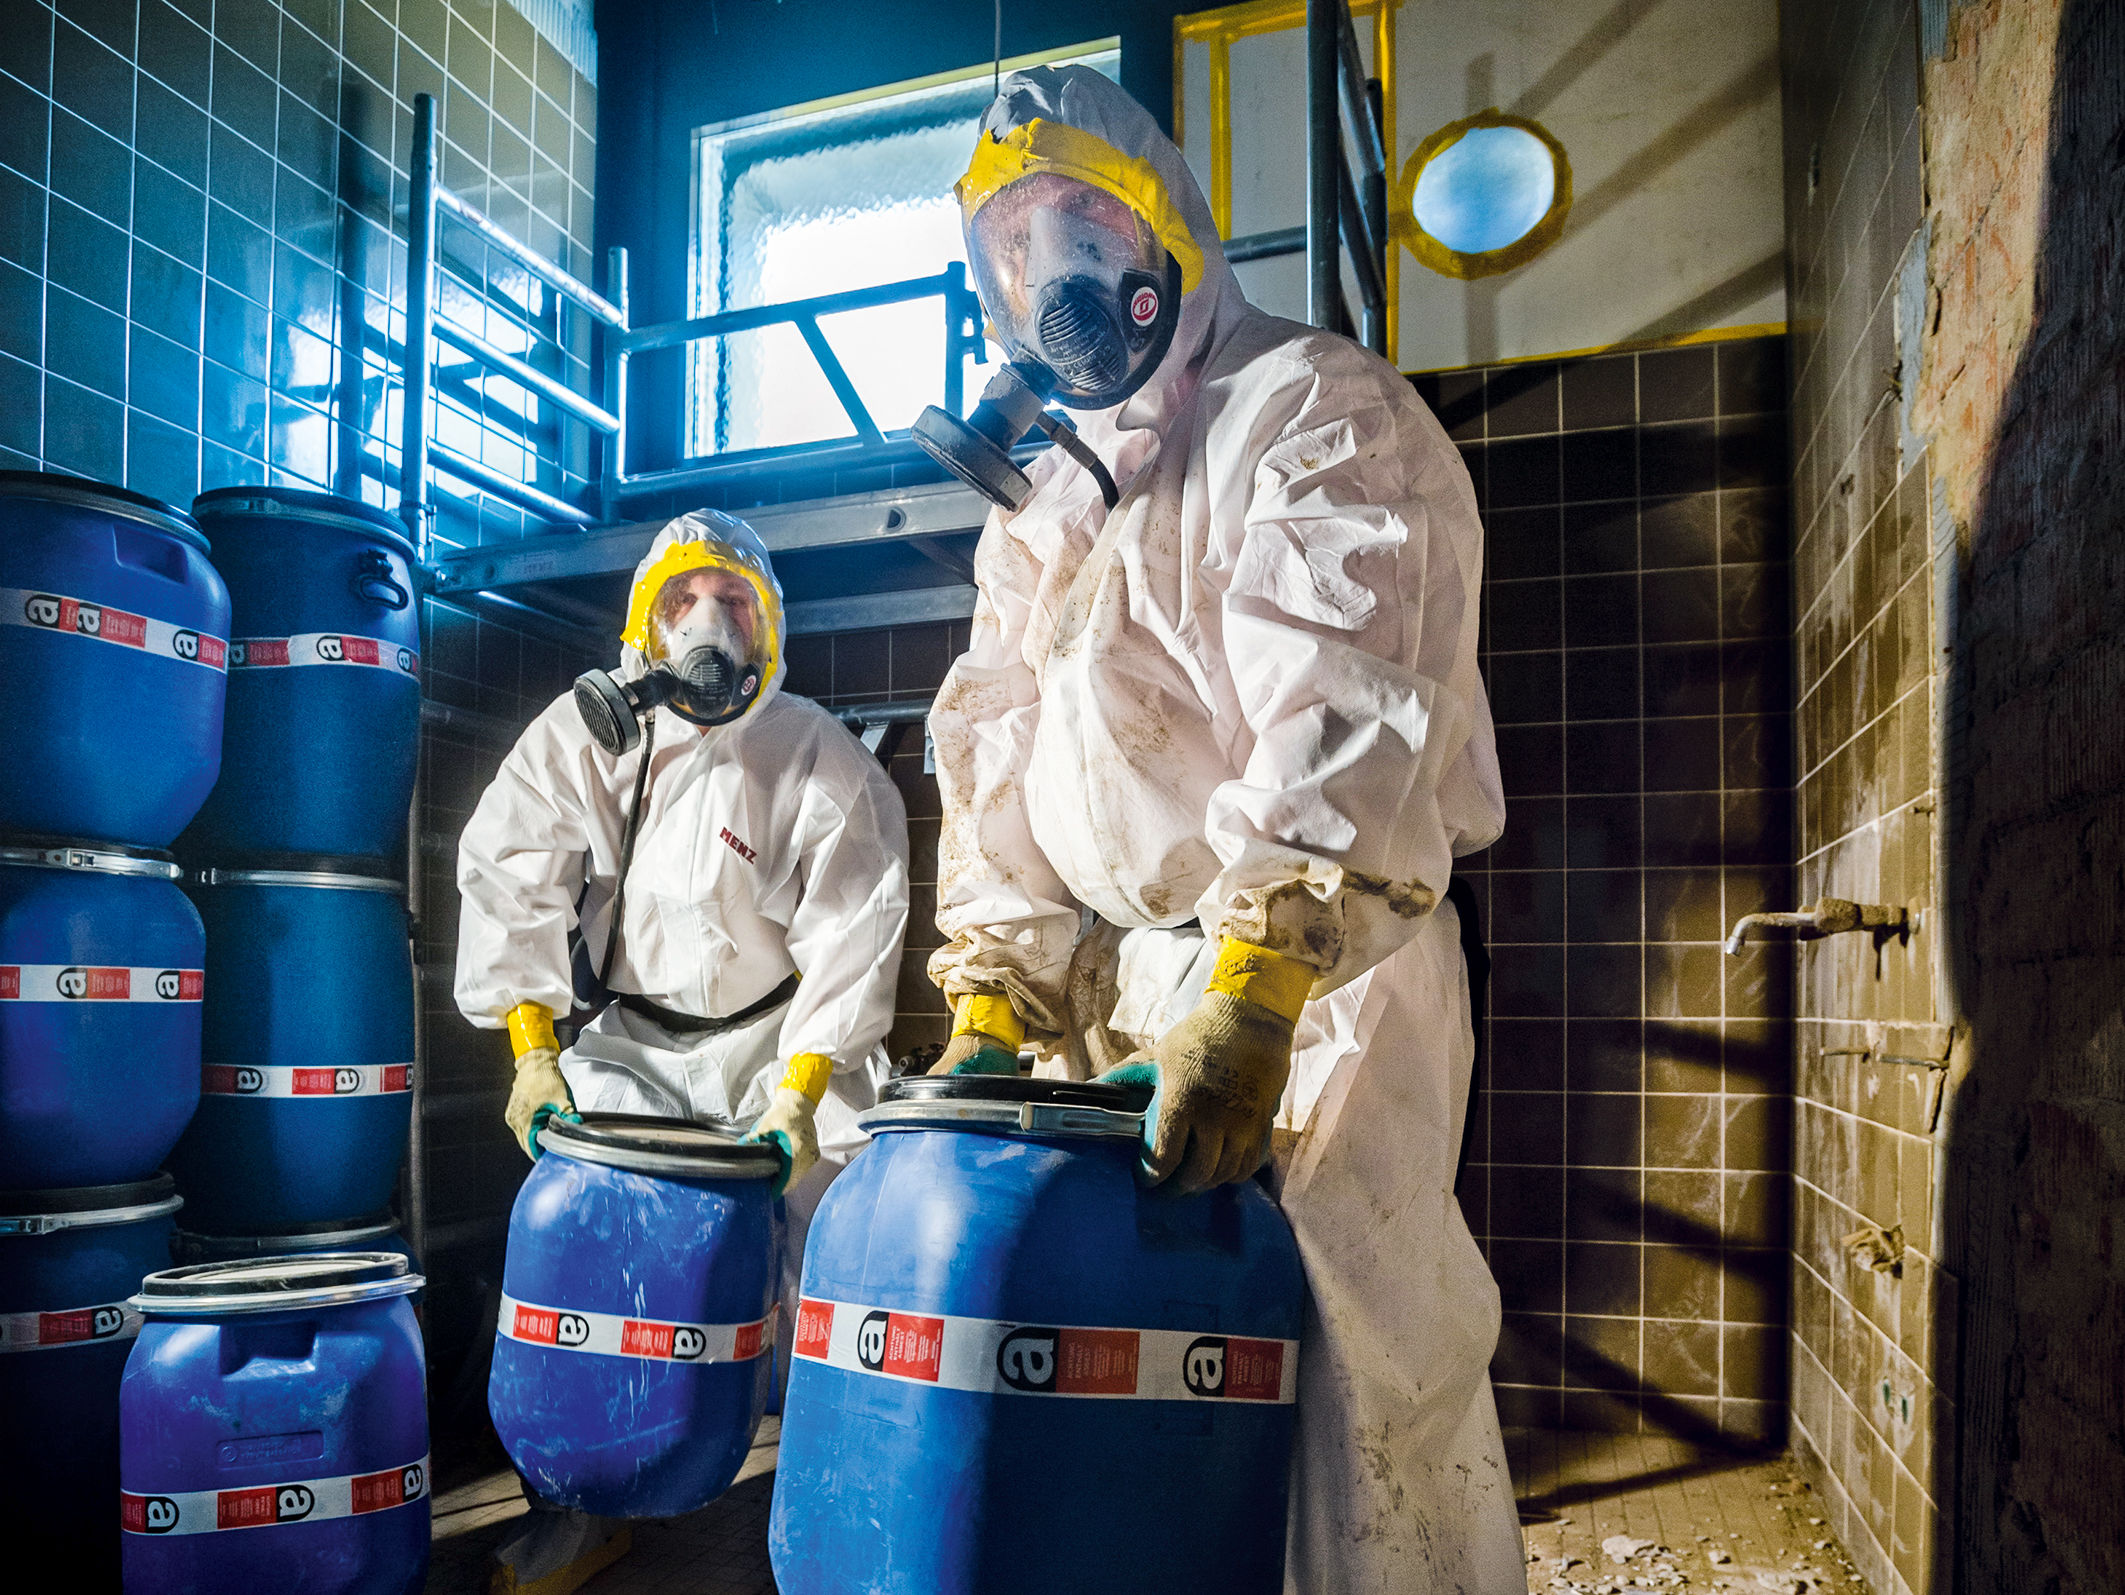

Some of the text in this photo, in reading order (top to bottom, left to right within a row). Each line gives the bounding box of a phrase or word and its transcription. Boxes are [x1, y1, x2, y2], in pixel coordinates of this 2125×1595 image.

[27, 598, 60, 625] a
[77, 606, 101, 633] a
[174, 632, 198, 658] a
[317, 638, 343, 659] a
[398, 649, 411, 671] a
[719, 826, 758, 865] MENZ
[58, 971, 87, 996] a
[157, 973, 180, 997] a
[237, 1070, 260, 1090] a
[335, 1070, 358, 1091] a
[94, 1310, 122, 1336] a
[558, 1315, 587, 1345] a
[674, 1328, 704, 1356] a
[858, 1319, 888, 1365] a
[1002, 1337, 1055, 1386] a
[1187, 1345, 1225, 1390] a
[404, 1468, 422, 1497] a
[147, 1501, 176, 1528] a
[279, 1489, 311, 1517] a
